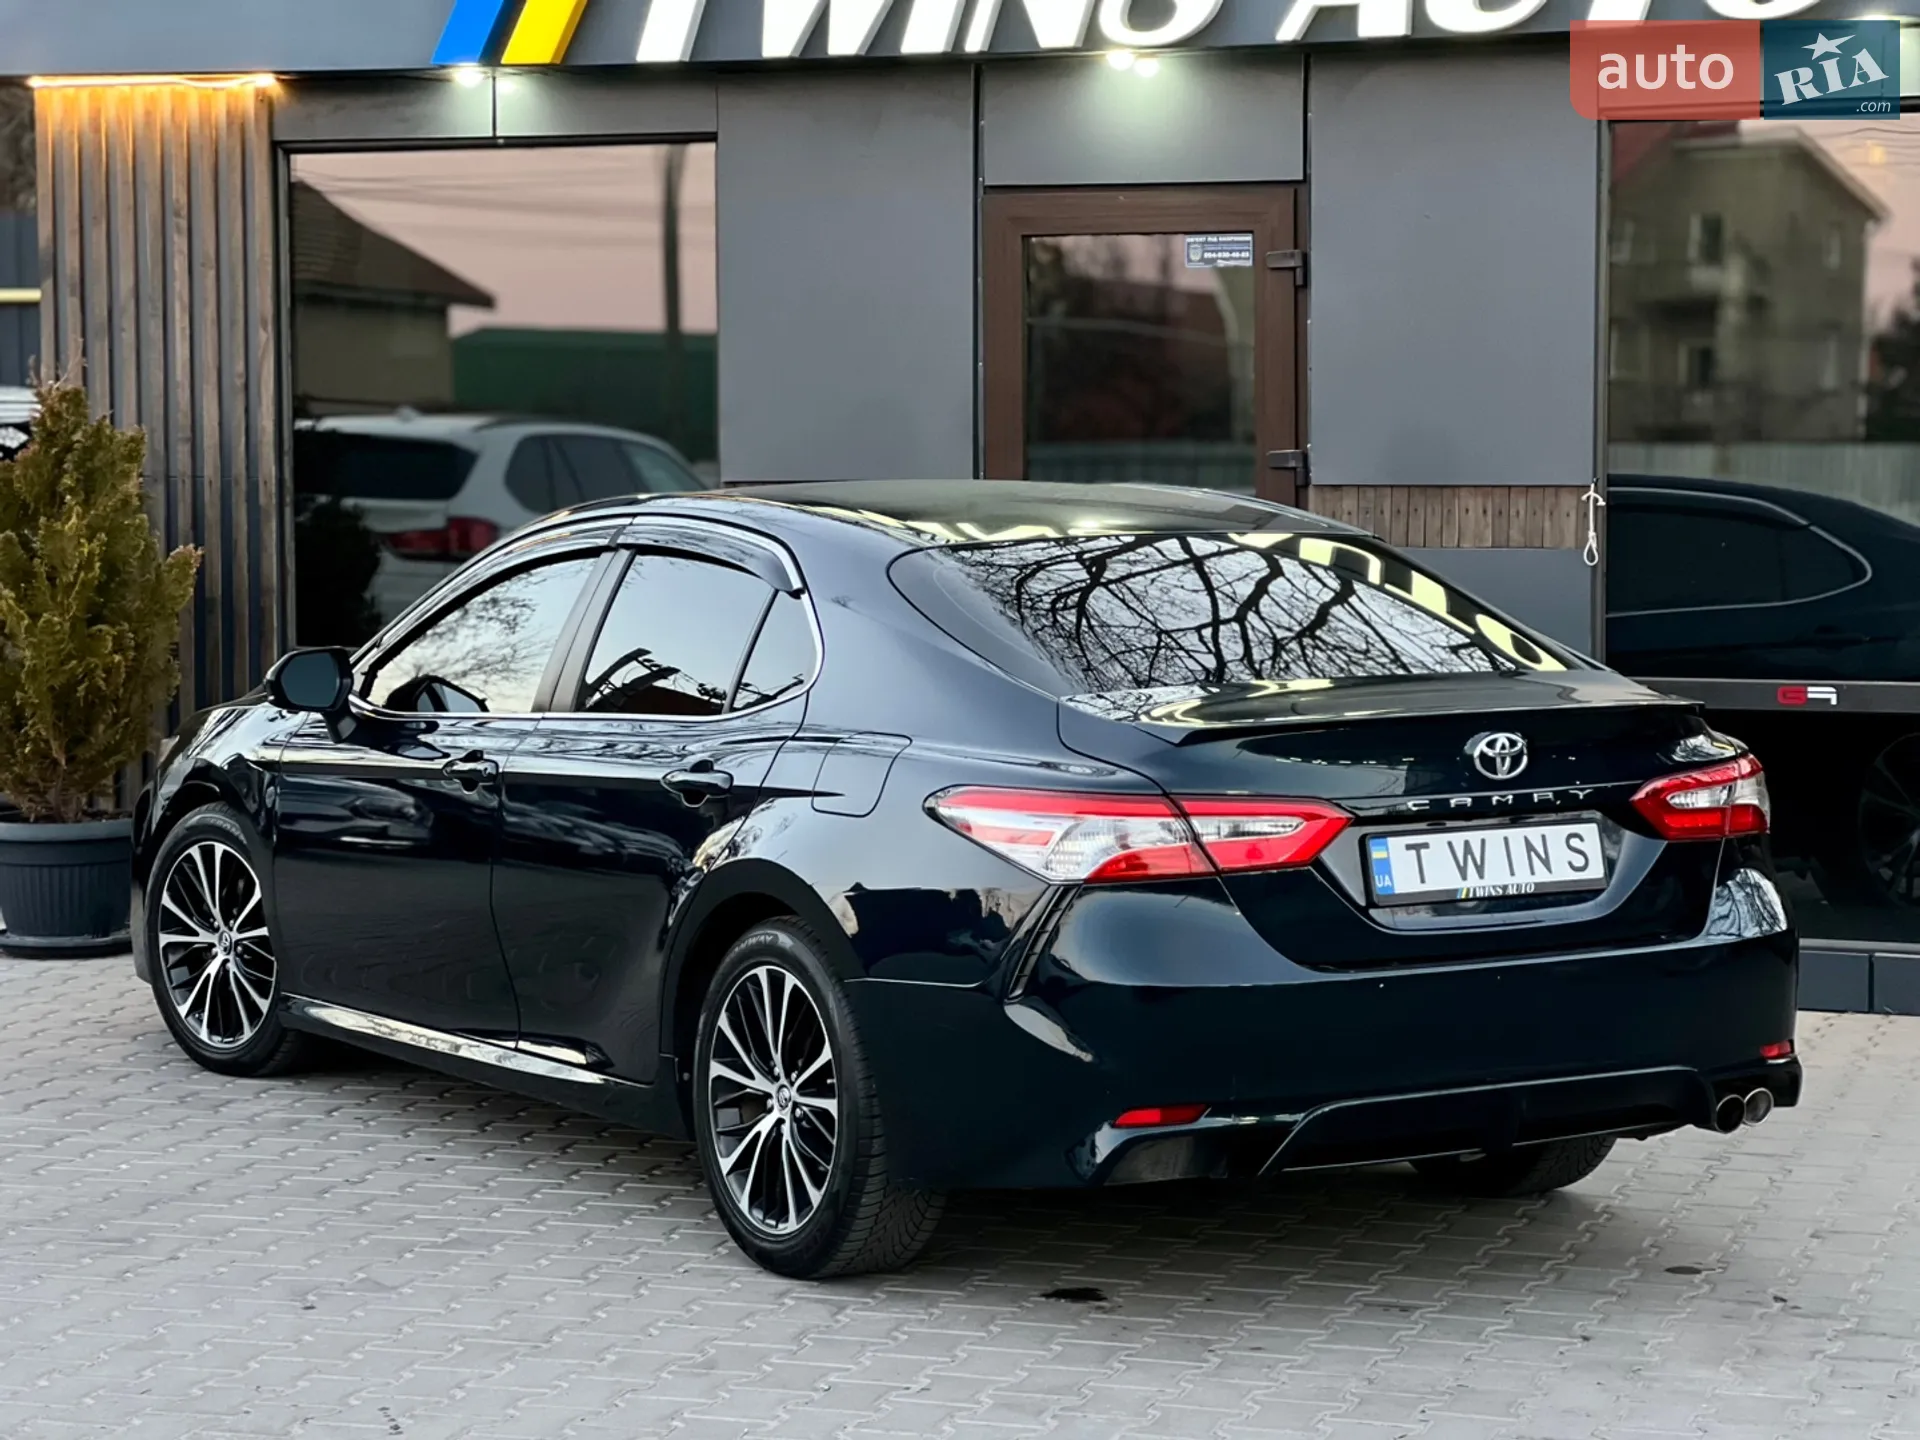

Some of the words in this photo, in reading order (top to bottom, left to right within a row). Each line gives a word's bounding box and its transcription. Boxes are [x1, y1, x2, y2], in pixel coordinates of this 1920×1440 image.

[1778, 687, 1837, 705] GR
[1407, 789, 1594, 811] CAMRY
[1405, 832, 1590, 885] TWINS
[1374, 874, 1392, 888] UA
[1468, 884, 1504, 898] TWINS
[1505, 882, 1535, 895] AUTO
